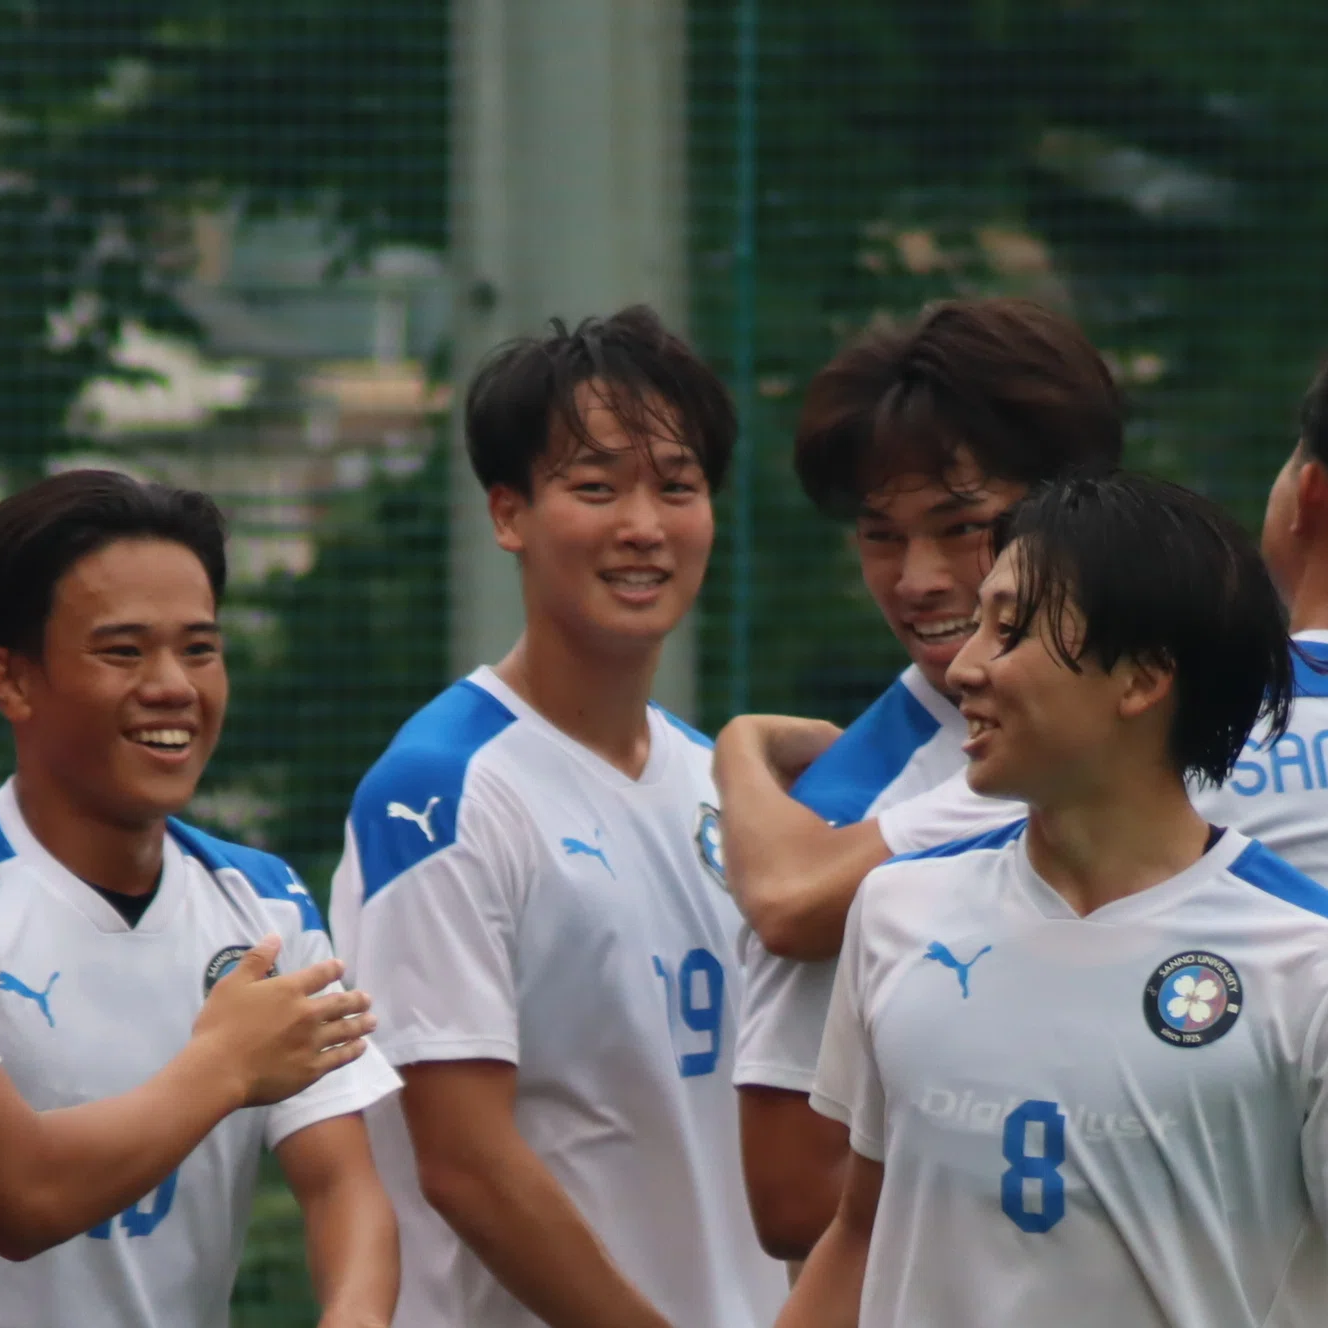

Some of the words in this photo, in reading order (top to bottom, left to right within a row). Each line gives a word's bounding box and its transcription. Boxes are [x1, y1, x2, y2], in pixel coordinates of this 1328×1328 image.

[1159, 955, 1194, 977] SANNO
[1197, 955, 1238, 993] UNIVERSITY
[1001, 1099, 1066, 1233] 8
